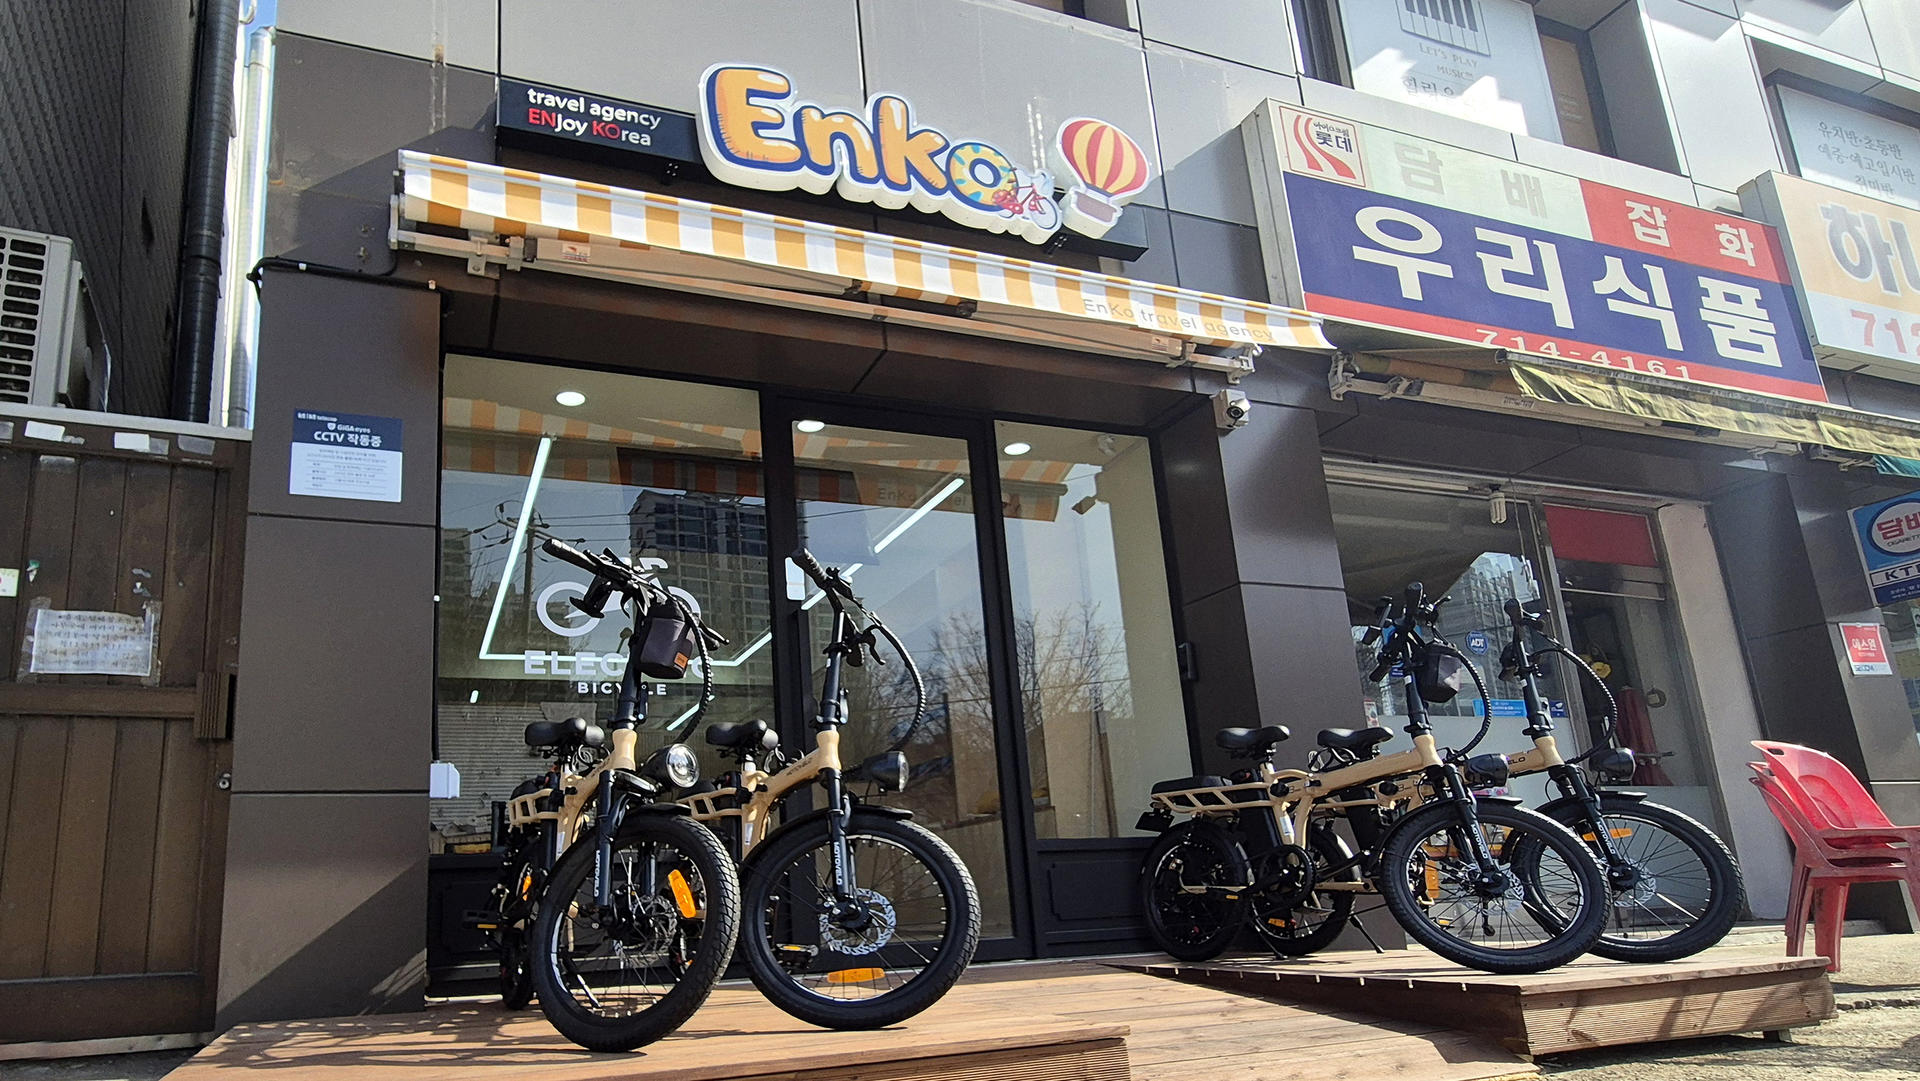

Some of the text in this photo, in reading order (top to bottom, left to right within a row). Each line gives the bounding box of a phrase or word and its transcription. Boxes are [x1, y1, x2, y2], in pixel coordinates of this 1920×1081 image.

[527, 88, 661, 130] travel agency
[528, 108, 651, 146] ENjoy KOrea
[1315, 131, 1352, 153] 롯데
[1352, 205, 1783, 368] 우리식품
[1084, 298, 1273, 341] EnKo travel agency
[1476, 328, 1691, 380] 714-4161
[313, 431, 382, 448] CCTV 작동중
